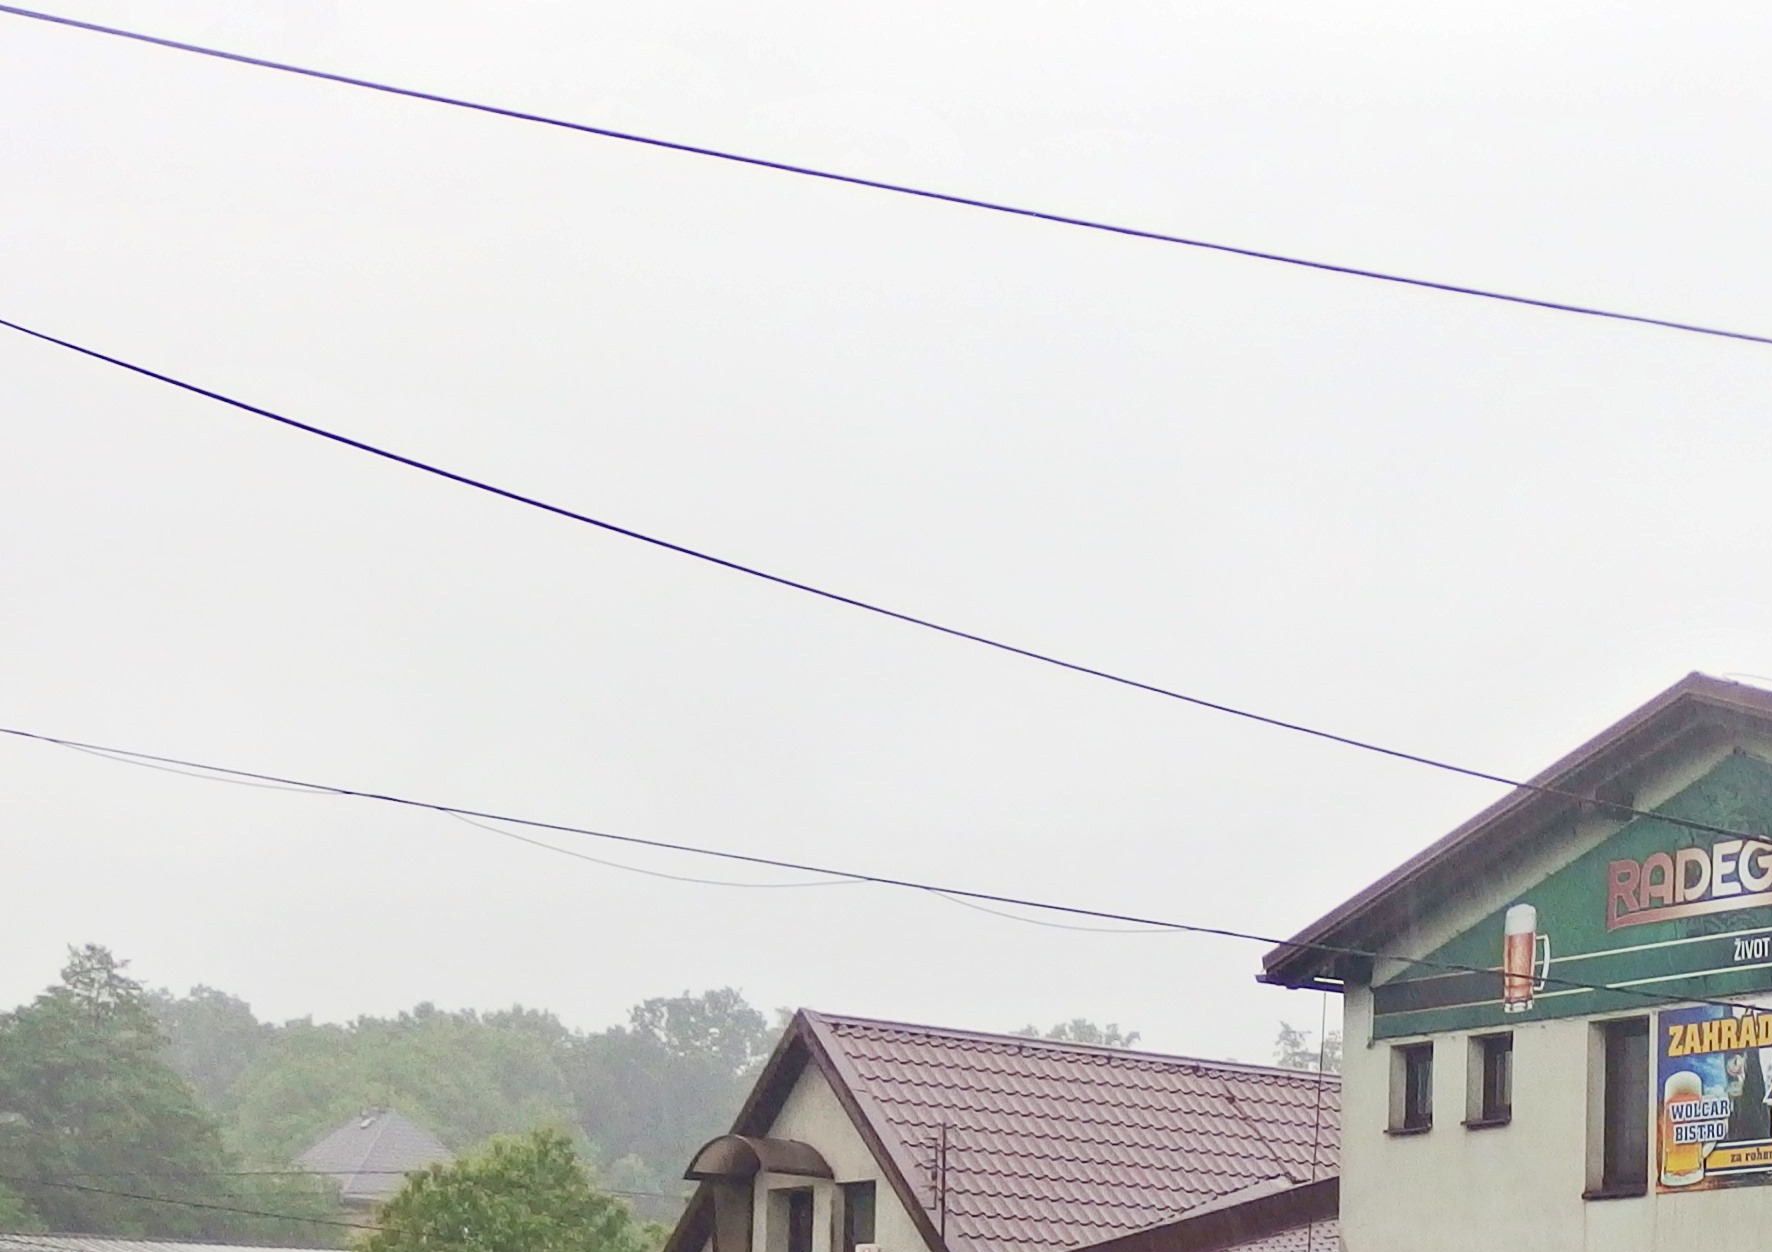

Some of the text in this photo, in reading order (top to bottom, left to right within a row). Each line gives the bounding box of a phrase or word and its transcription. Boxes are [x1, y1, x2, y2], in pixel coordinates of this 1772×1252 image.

[1734, 937, 1770, 962] ŽIVOT
[1671, 1100, 1730, 1120] WOLCAR
[1675, 1121, 1725, 1142] BISTRO
[1730, 1153, 1742, 1163] za
